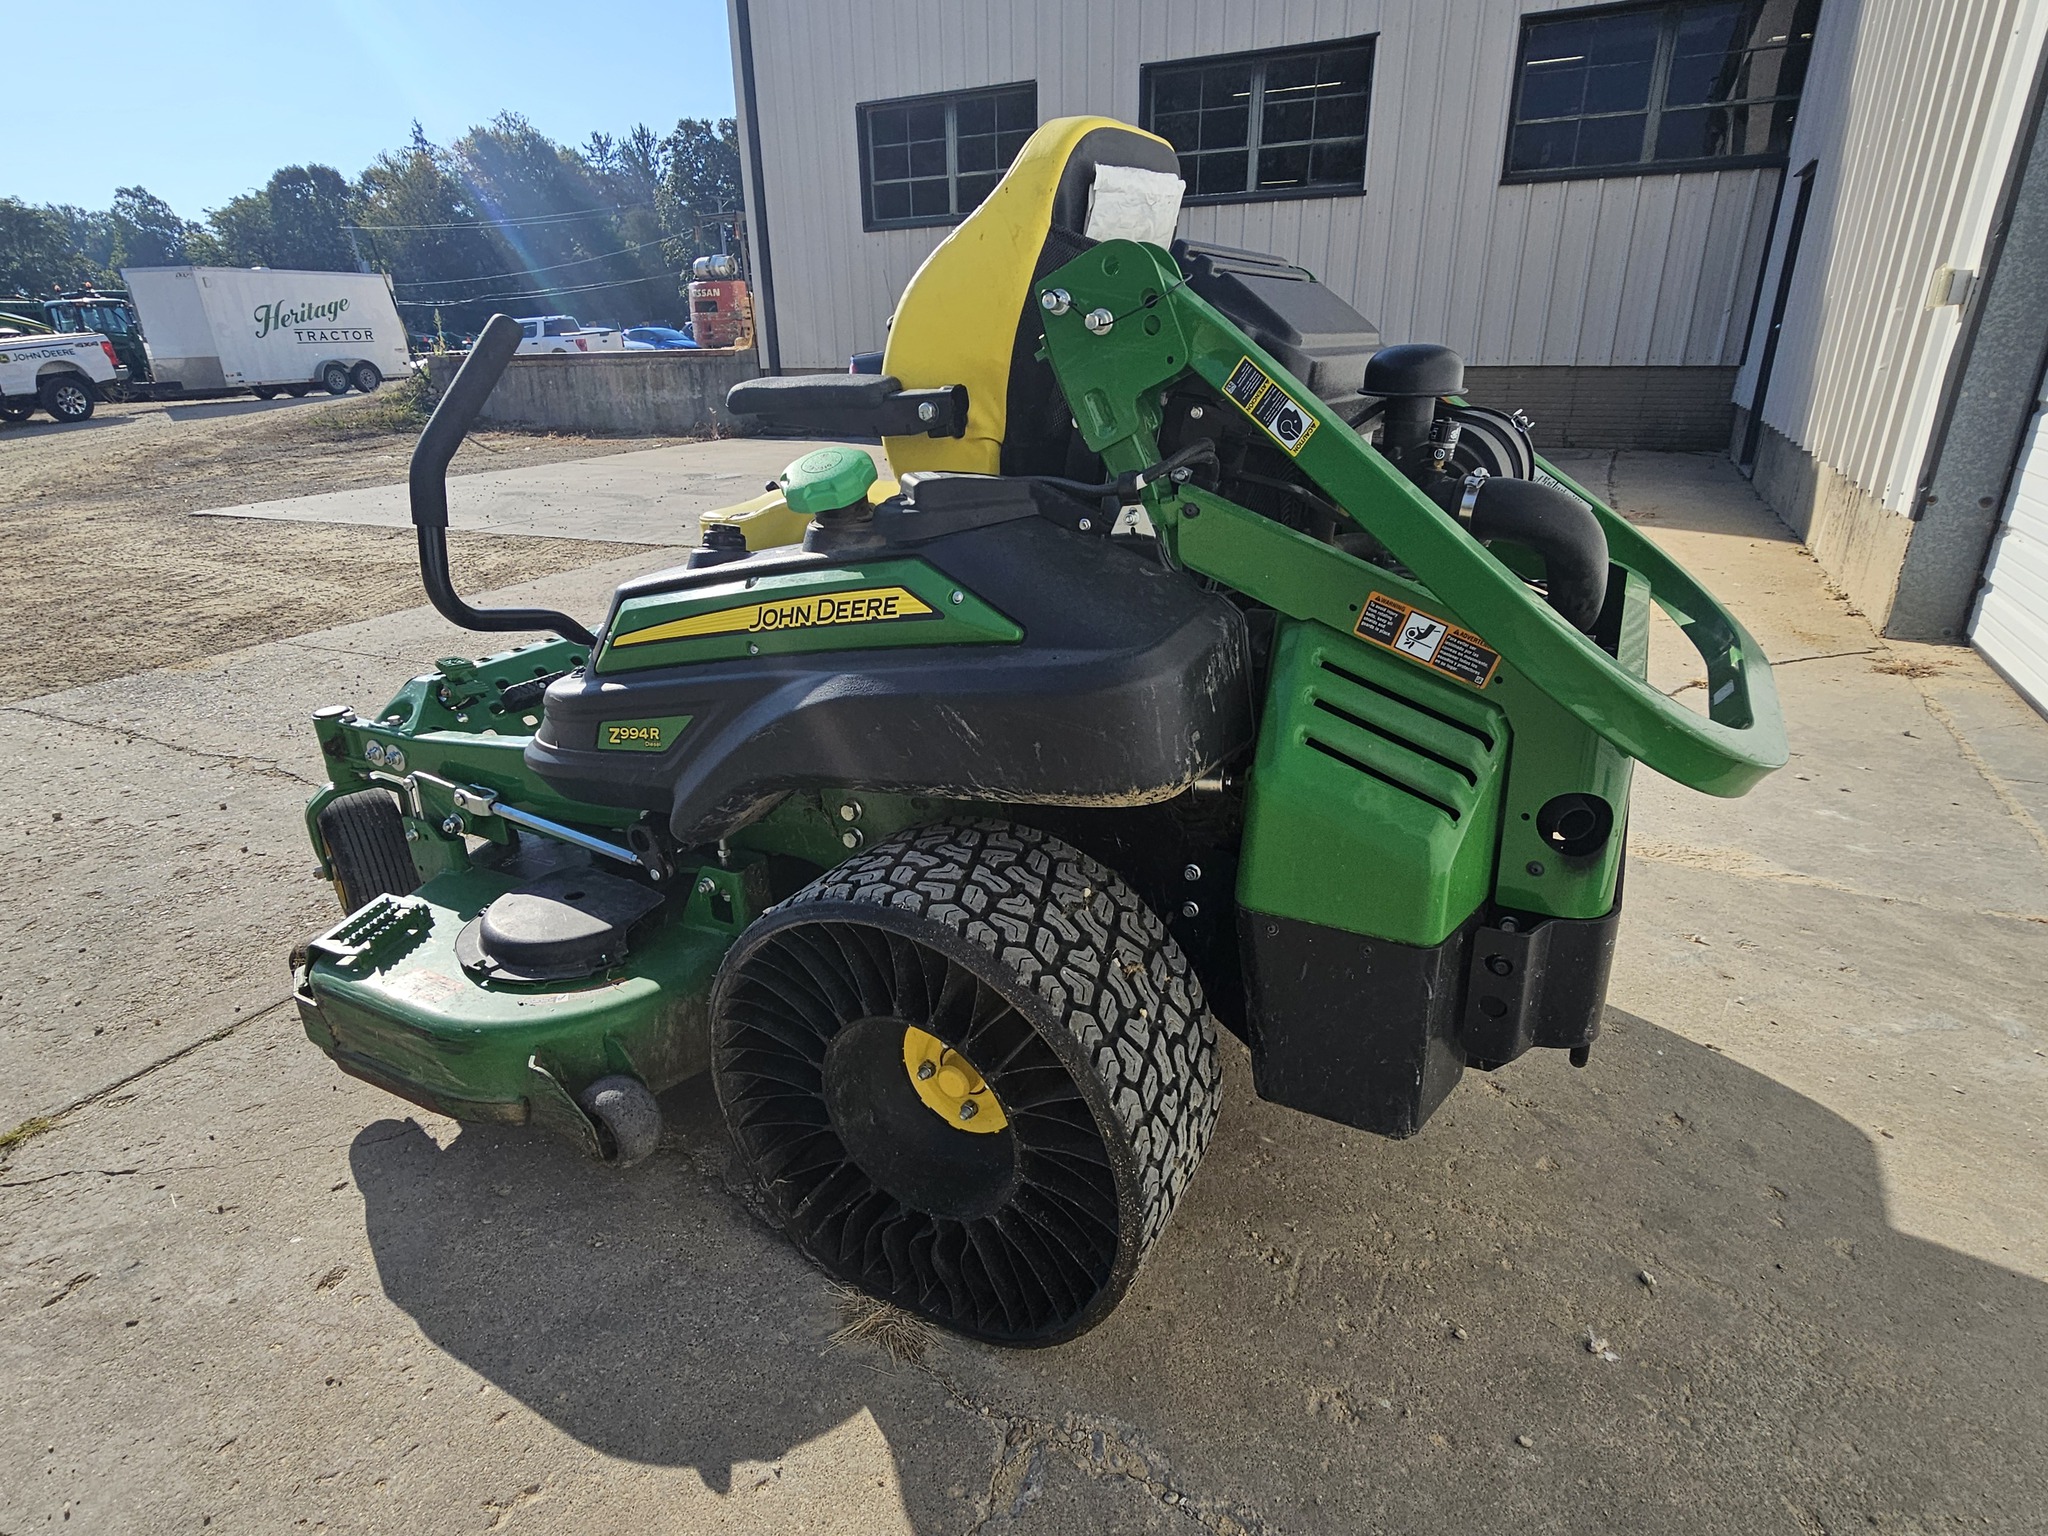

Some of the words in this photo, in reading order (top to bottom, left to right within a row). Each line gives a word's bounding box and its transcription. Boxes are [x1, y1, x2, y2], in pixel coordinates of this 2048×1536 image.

[691, 288, 720, 297] ISSAN
[254, 298, 350, 339] Heritage
[294, 330, 374, 342] TRACTOR
[12, 351, 41, 362] JOHN
[42, 348, 76, 359] DEERE
[1293, 427, 1314, 454] CAUTION
[1380, 597, 1406, 612] WARNING
[749, 605, 811, 631] JOHN
[816, 596, 900, 622] DEERE
[609, 727, 660, 743] Z994R
